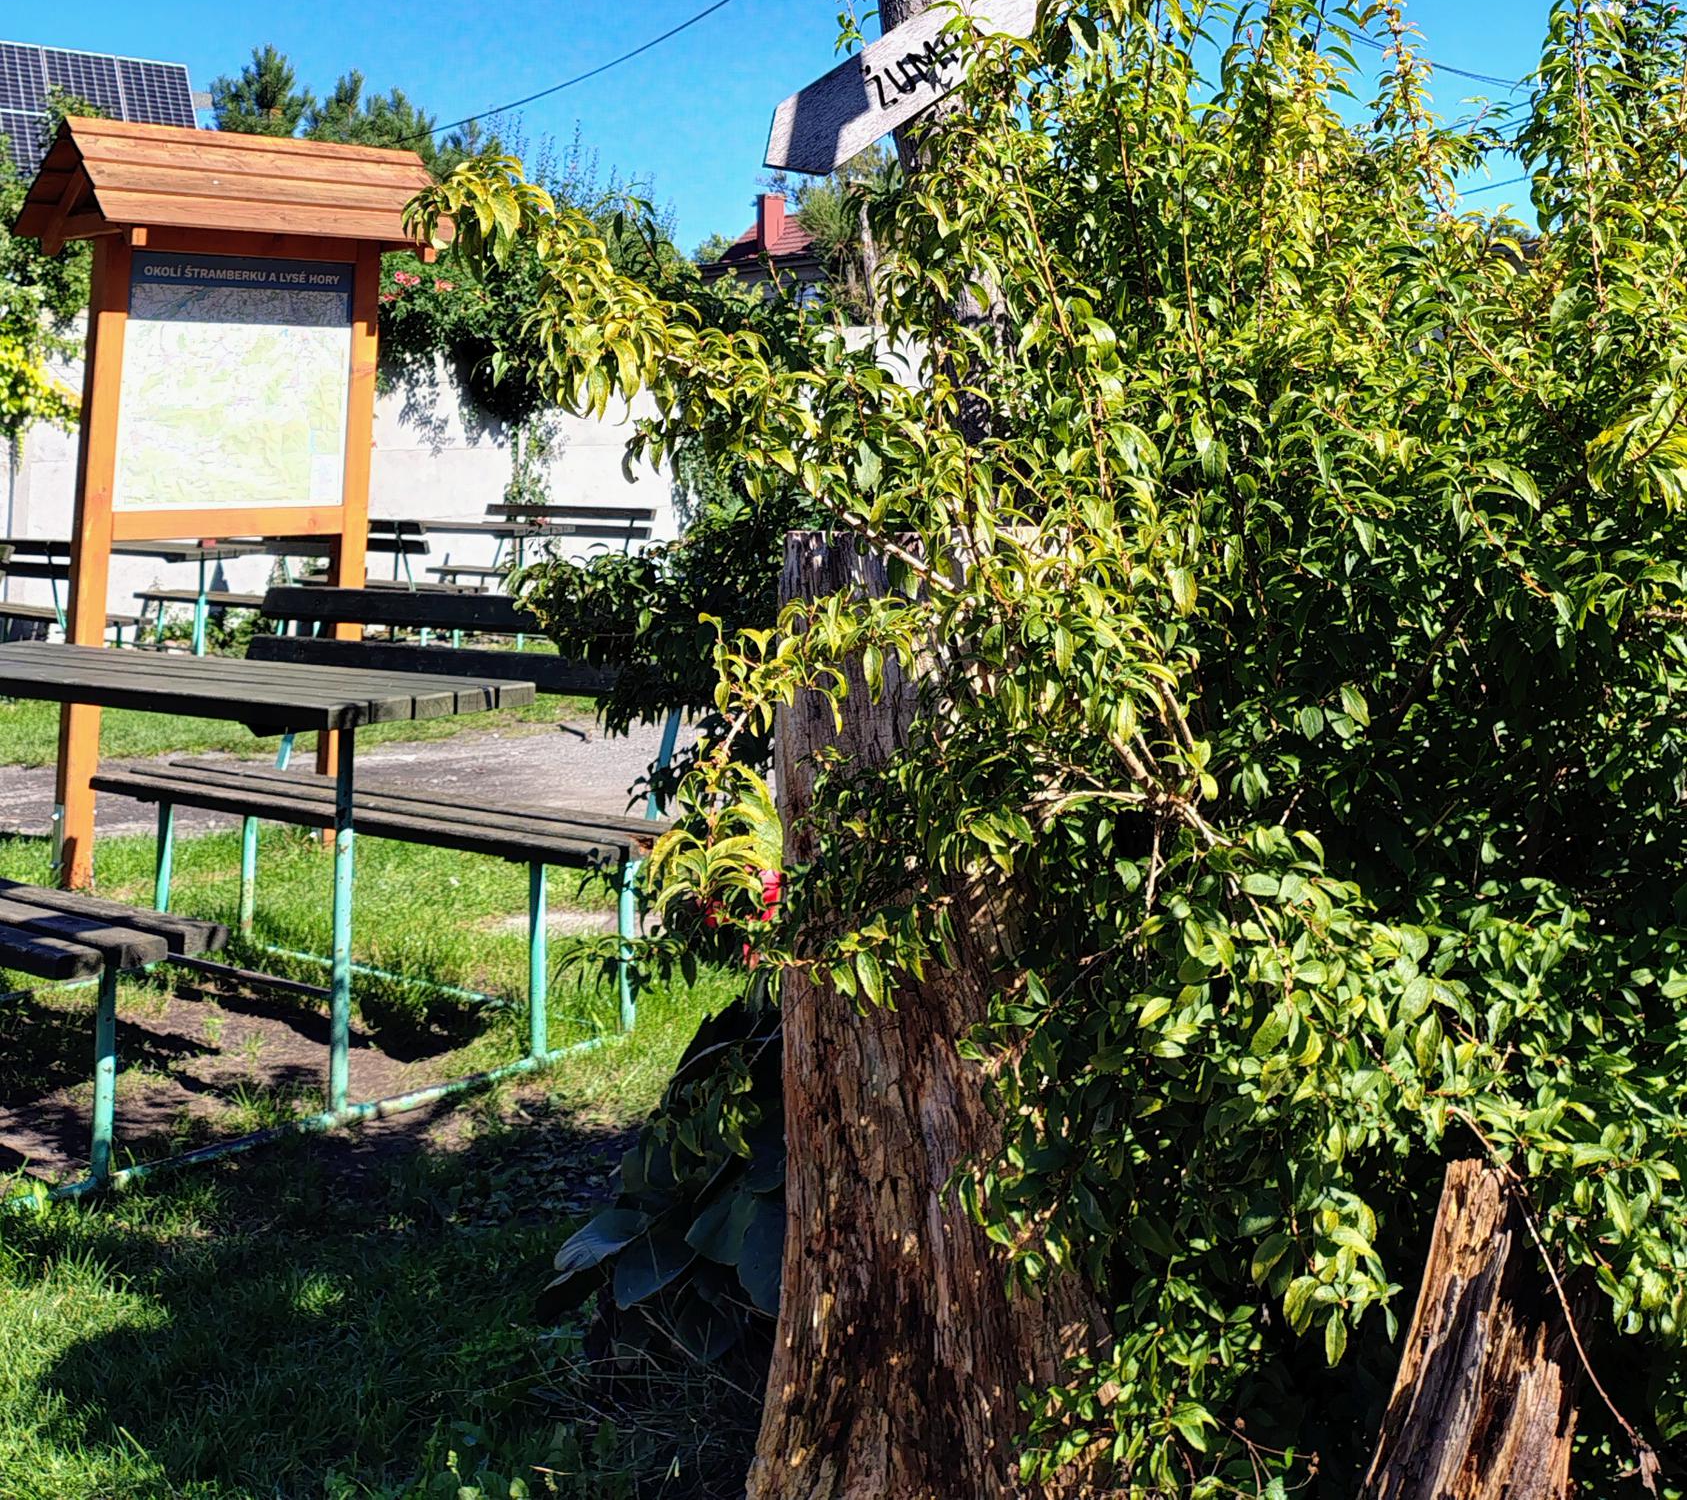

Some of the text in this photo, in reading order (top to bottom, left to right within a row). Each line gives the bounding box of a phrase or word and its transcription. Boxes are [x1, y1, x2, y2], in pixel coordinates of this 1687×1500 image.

[144, 265, 340, 285] OKOLÍ ŠTRAMBERKU A LYSÉ HORY
